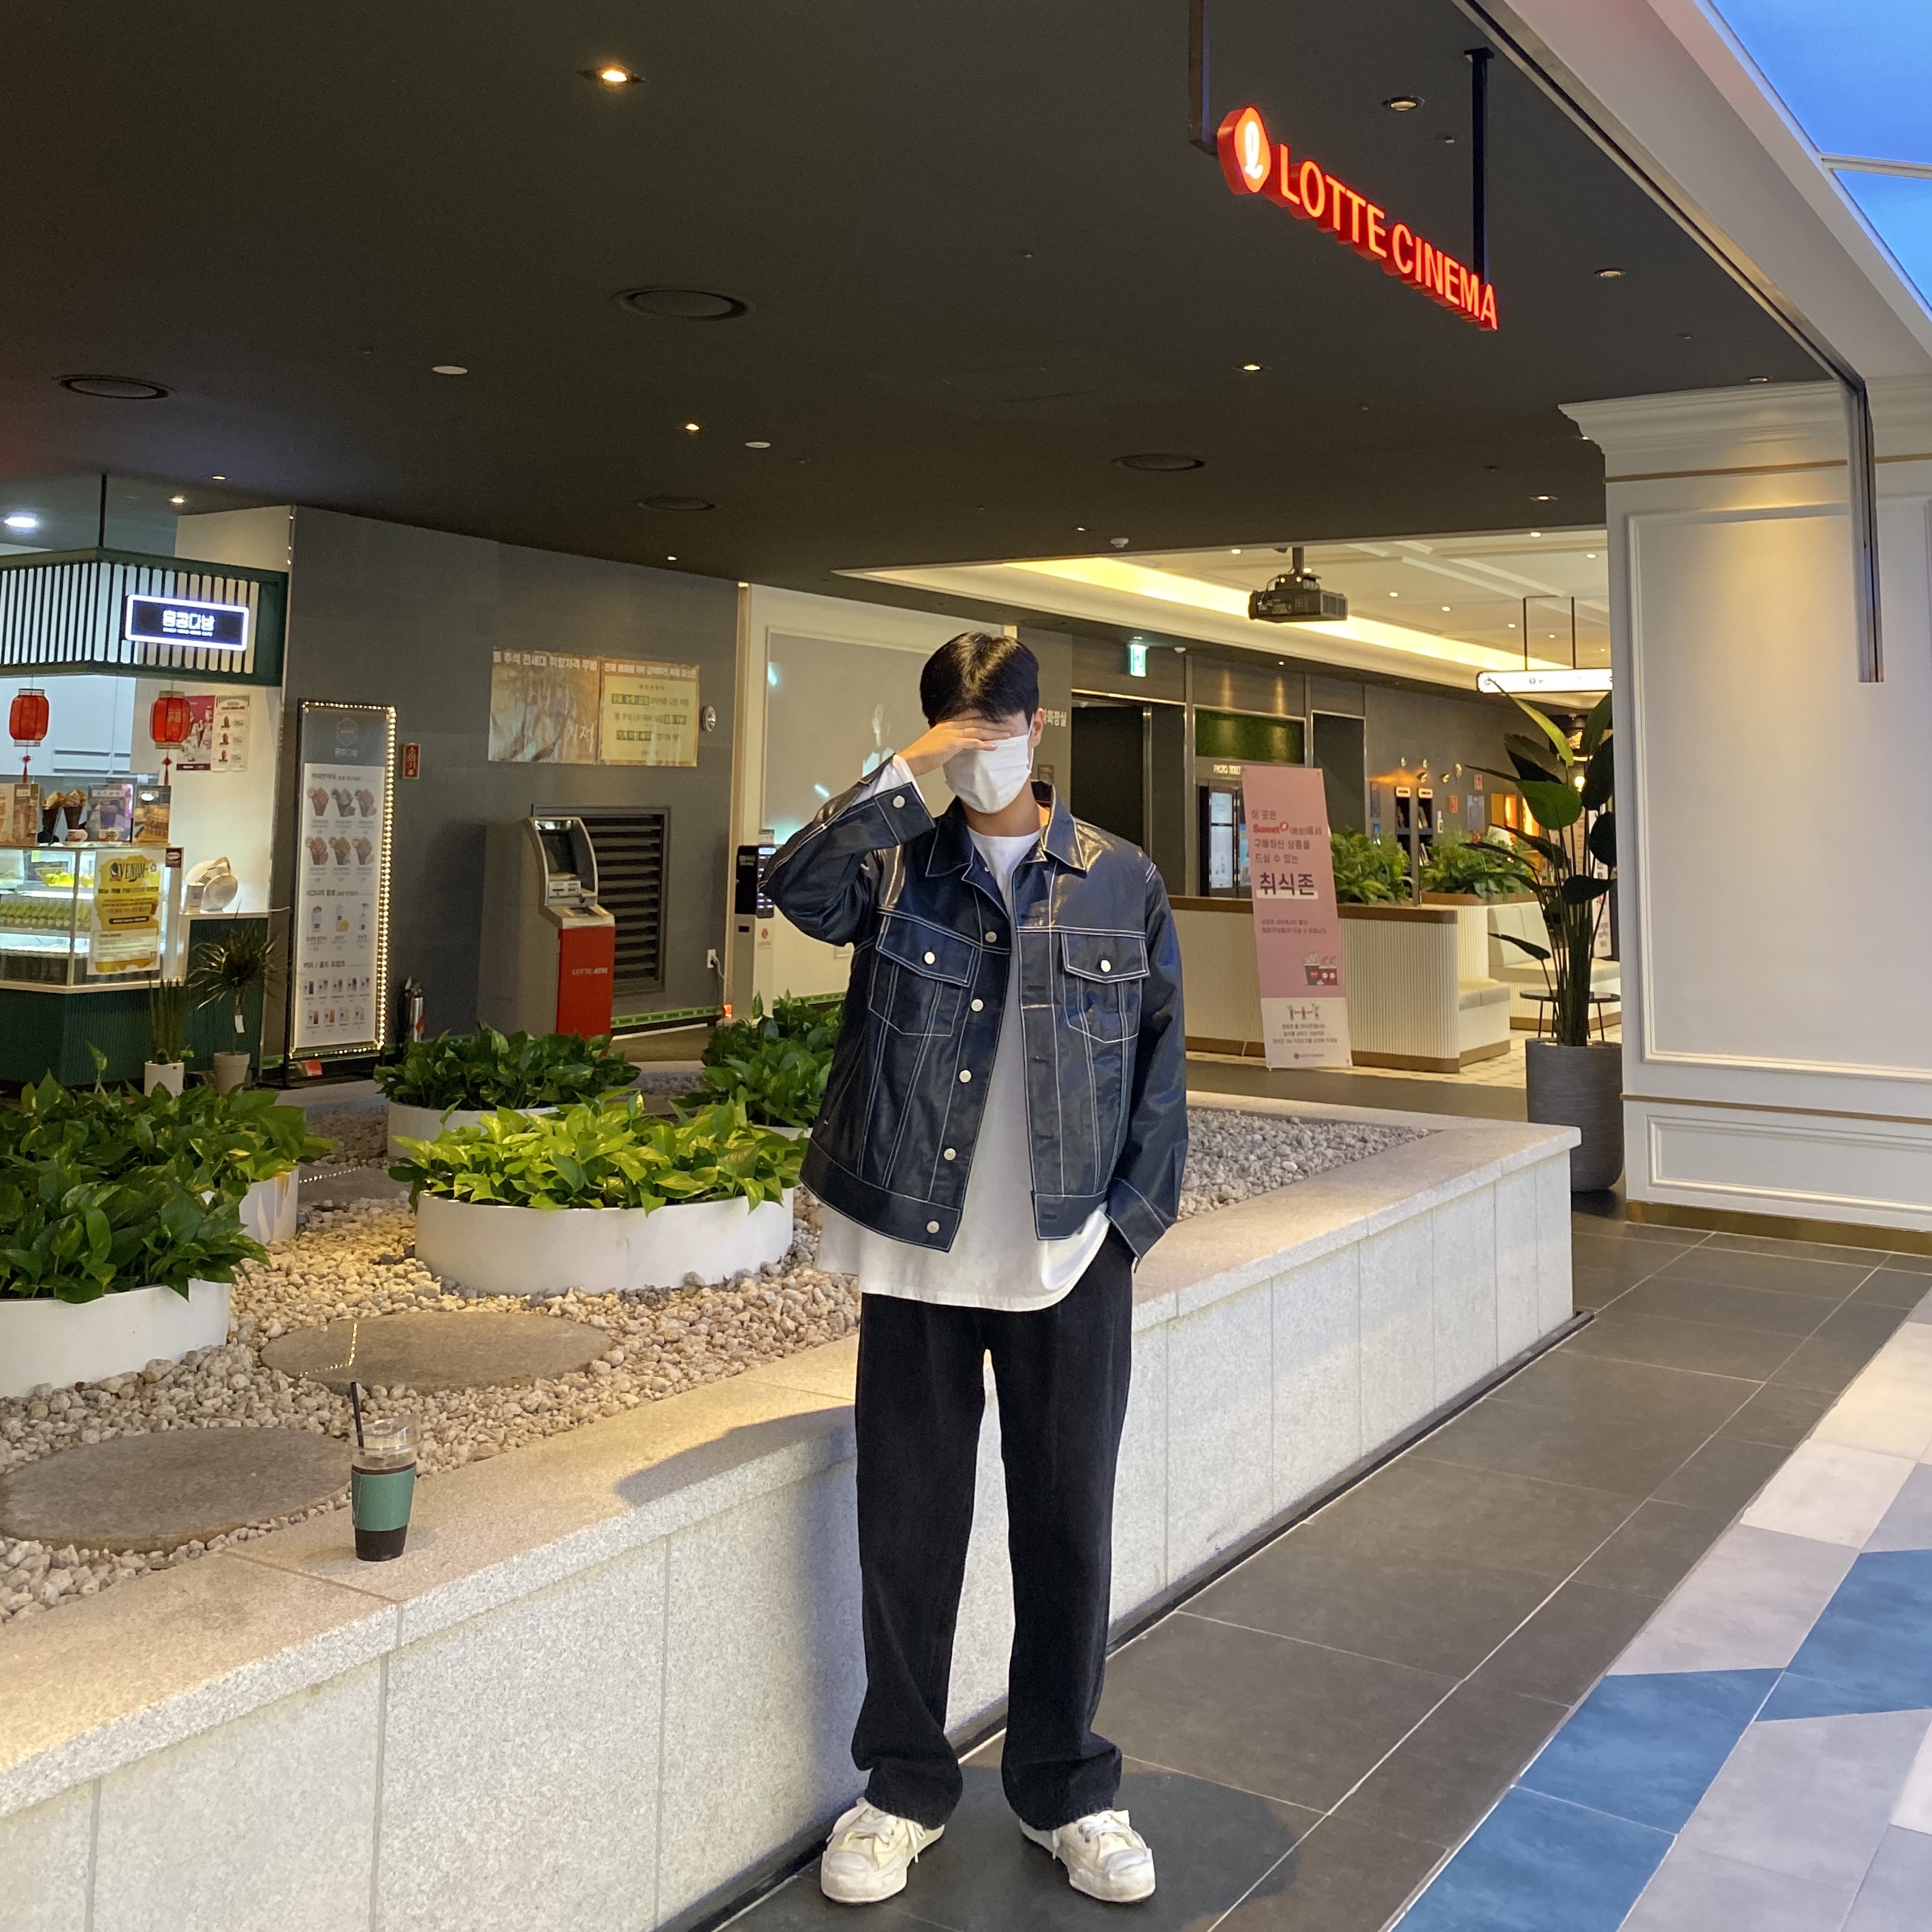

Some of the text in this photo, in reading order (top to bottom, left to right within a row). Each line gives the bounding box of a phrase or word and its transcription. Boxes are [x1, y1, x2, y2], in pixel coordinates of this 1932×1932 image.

[1278, 142, 1388, 259] LOTTE
[1391, 223, 1499, 331] CINEMA
[504, 652, 520, 665] 추석
[523, 654, 548, 667] 전세대
[582, 659, 598, 672] 무비
[1251, 810, 1277, 821] 이 곳은
[1253, 823, 1280, 834] Sweet
[1254, 838, 1311, 850] 구매하신 상품을
[1255, 853, 1299, 864] 드실 수 있는
[118, 862, 146, 883] VENOM
[1259, 872, 1315, 896] 취식존
